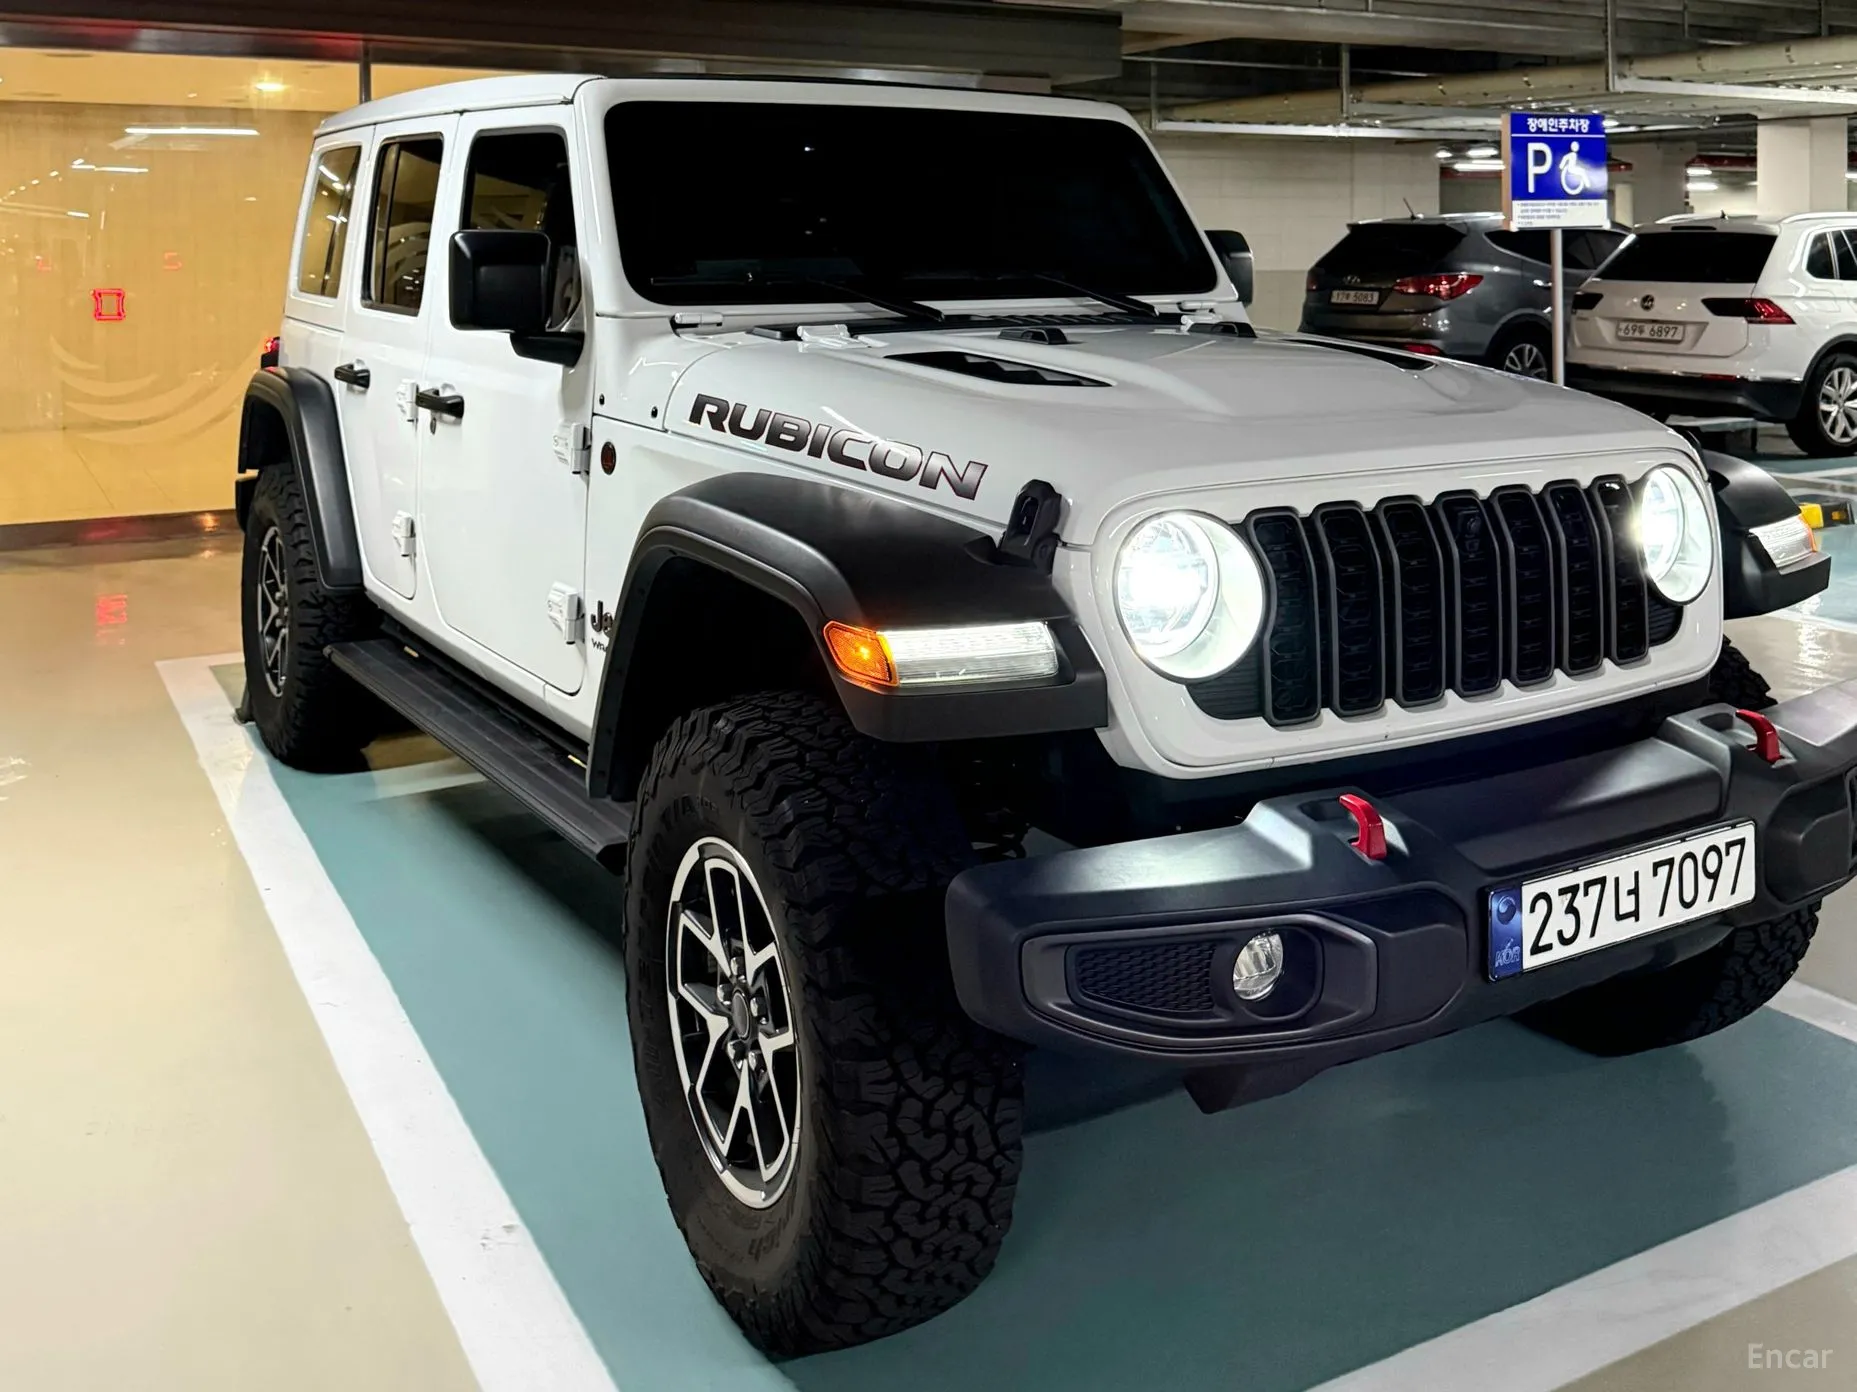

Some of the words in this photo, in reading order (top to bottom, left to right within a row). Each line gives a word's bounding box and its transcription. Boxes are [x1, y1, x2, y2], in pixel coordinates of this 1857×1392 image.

[1527, 118, 1590, 133] 장애인주차장
[1527, 142, 1553, 193] P
[1649, 326, 1678, 338] 6897
[689, 393, 988, 500] RUBICON
[1529, 871, 1639, 956] 237너
[1652, 837, 1746, 917] 7097
